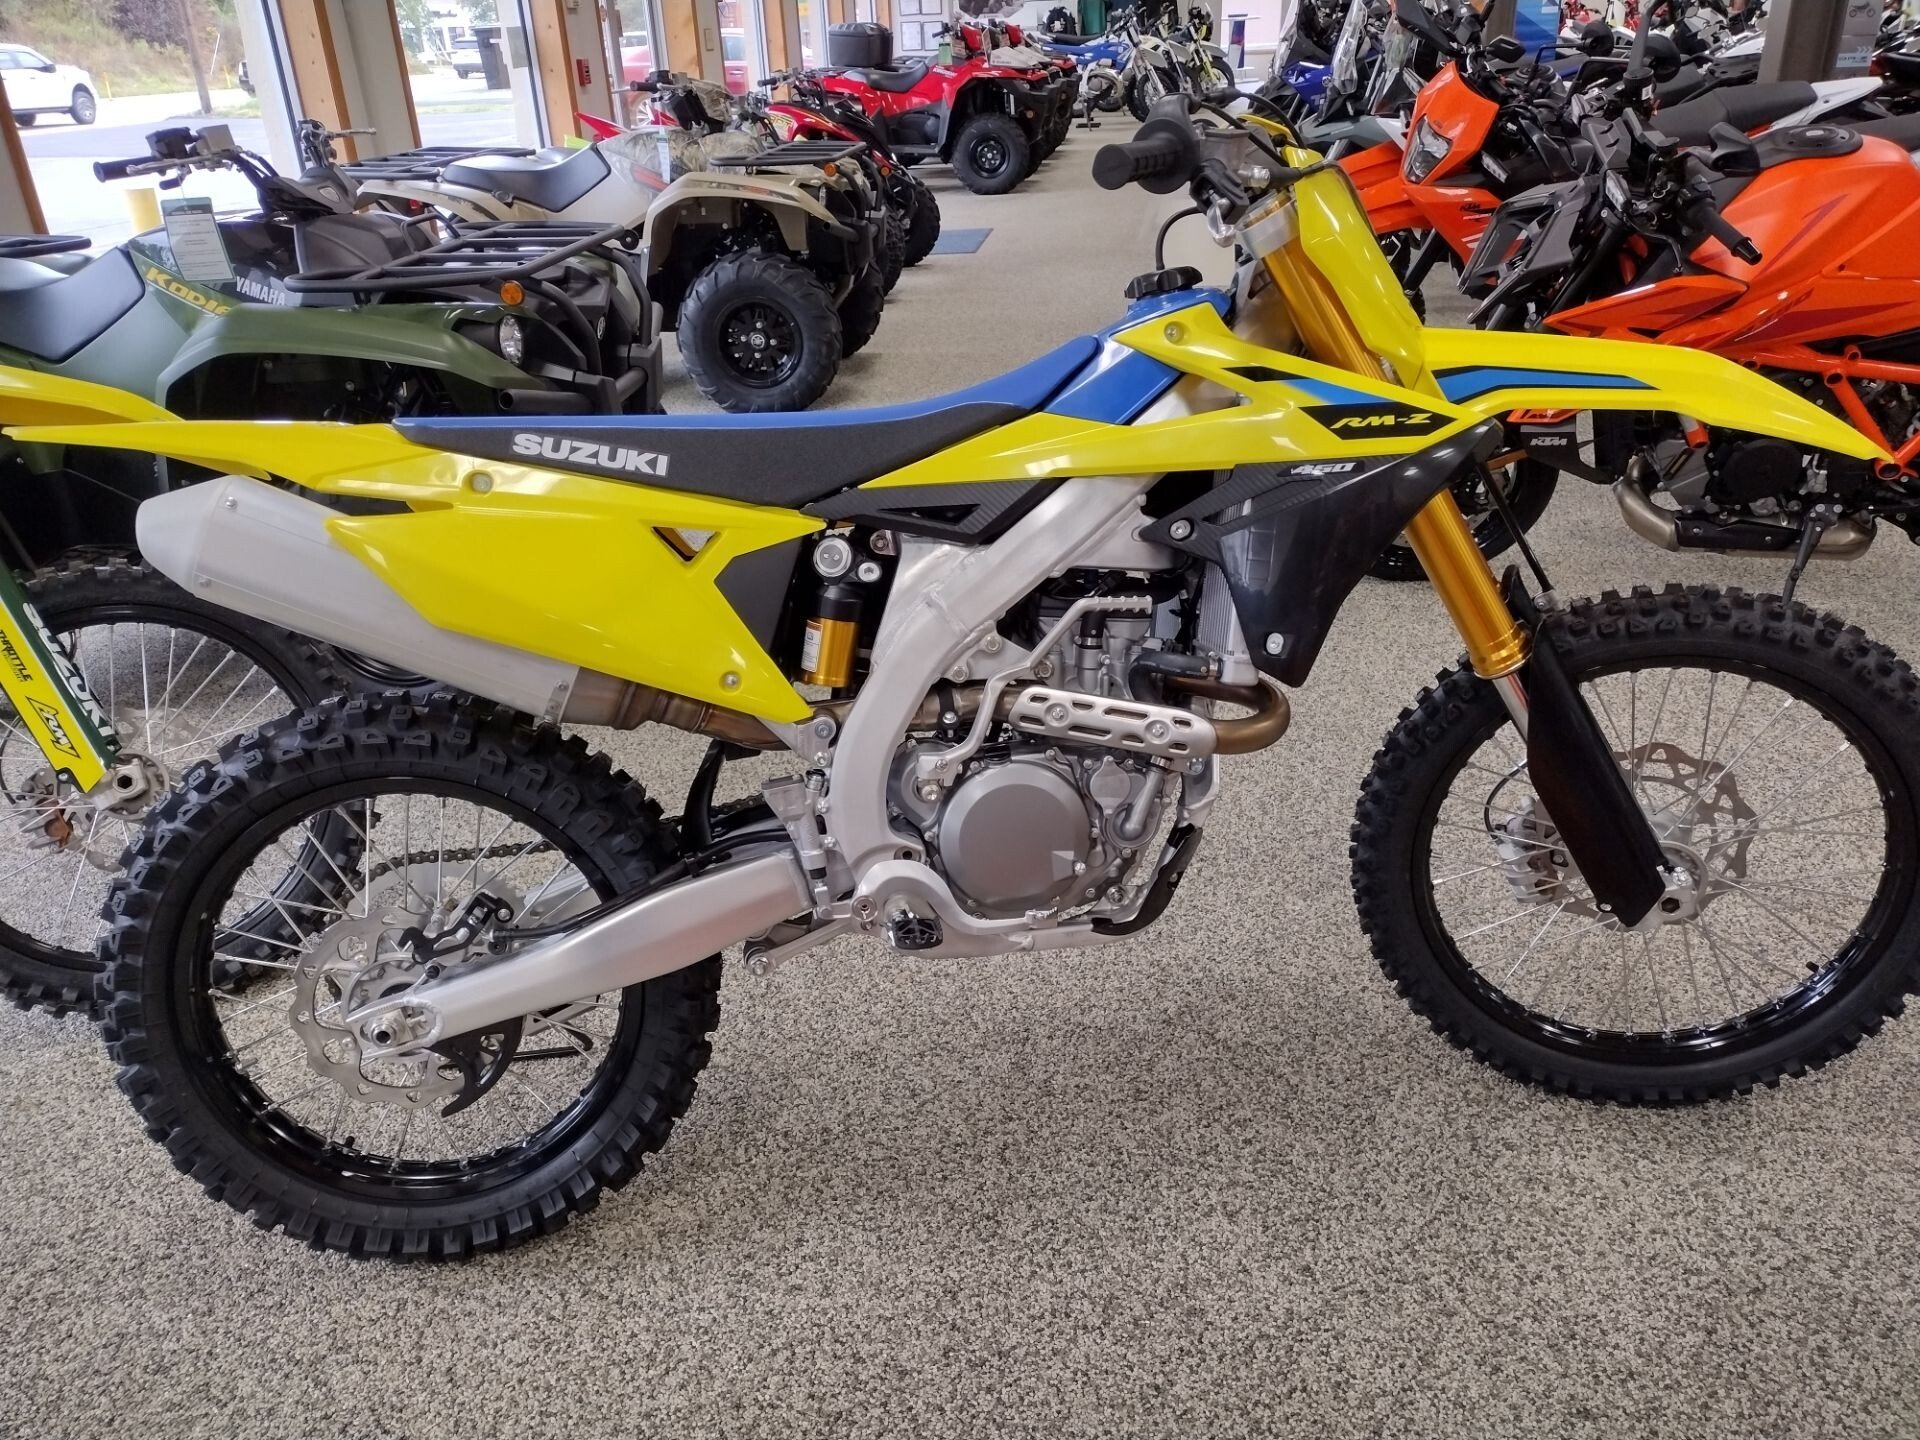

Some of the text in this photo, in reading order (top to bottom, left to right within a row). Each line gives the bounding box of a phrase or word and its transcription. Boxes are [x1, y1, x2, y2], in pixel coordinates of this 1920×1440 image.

[235, 275, 287, 306] YAMAHA
[1329, 412, 1433, 429] RM-Z
[1529, 436, 1568, 446] KTM
[512, 432, 669, 477] SUZUKI
[1290, 462, 1357, 476] 450
[22, 602, 116, 737] SUZUKI
